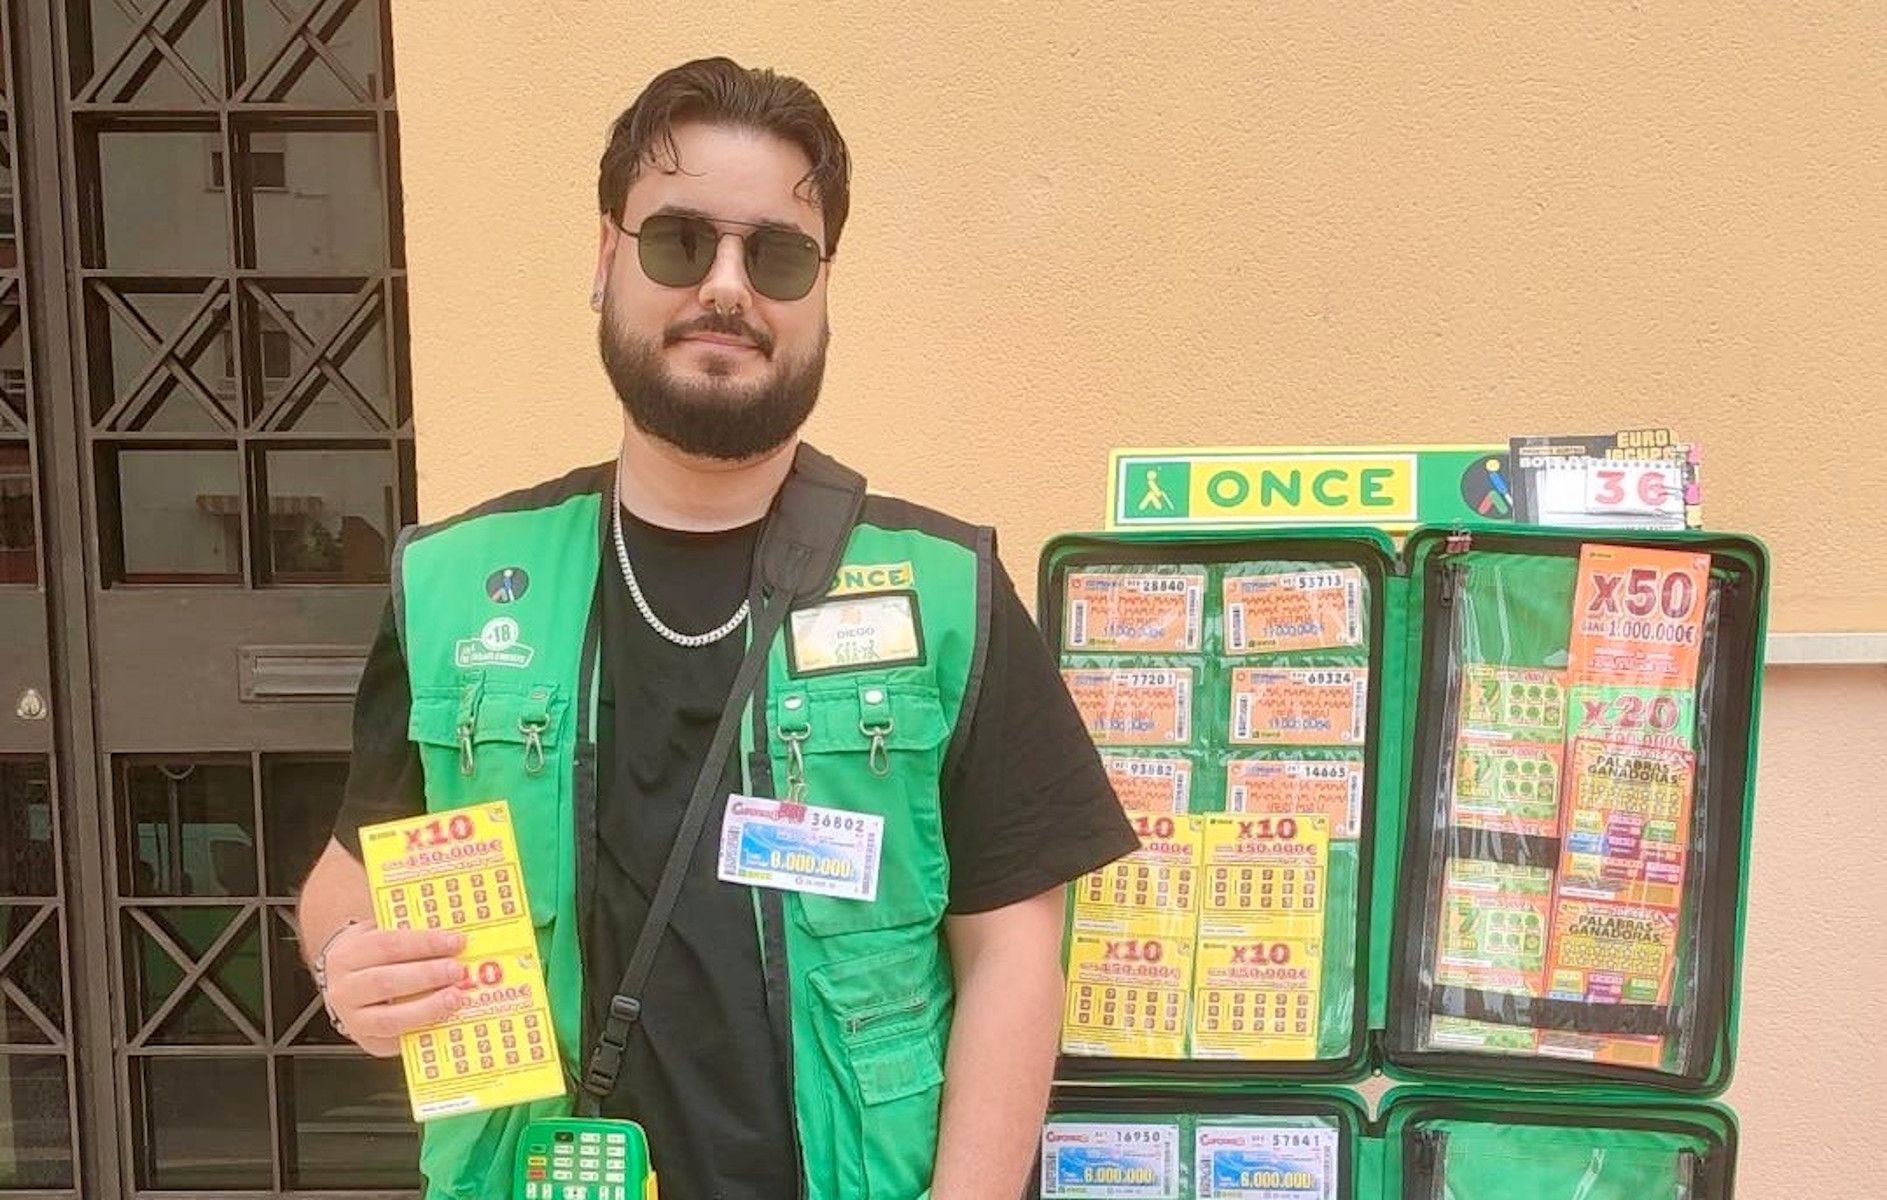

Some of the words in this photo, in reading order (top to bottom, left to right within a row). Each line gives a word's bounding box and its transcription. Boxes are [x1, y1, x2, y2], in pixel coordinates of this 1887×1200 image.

[1616, 429, 1670, 448] EURO
[1206, 468, 1394, 507] ONCE
[404, 815, 474, 848] x10
[811, 812, 865, 833] 36802
[1135, 816, 1175, 839] 10
[1237, 818, 1298, 840] x10
[1568, 924, 1662, 943] GANADORAS
[1578, 914, 1654, 932] PALABRAS
[1104, 939, 1164, 963] x10
[1231, 943, 1291, 965] x10
[1117, 1131, 1160, 1143] 16950
[1272, 1134, 1320, 1147] 57841
